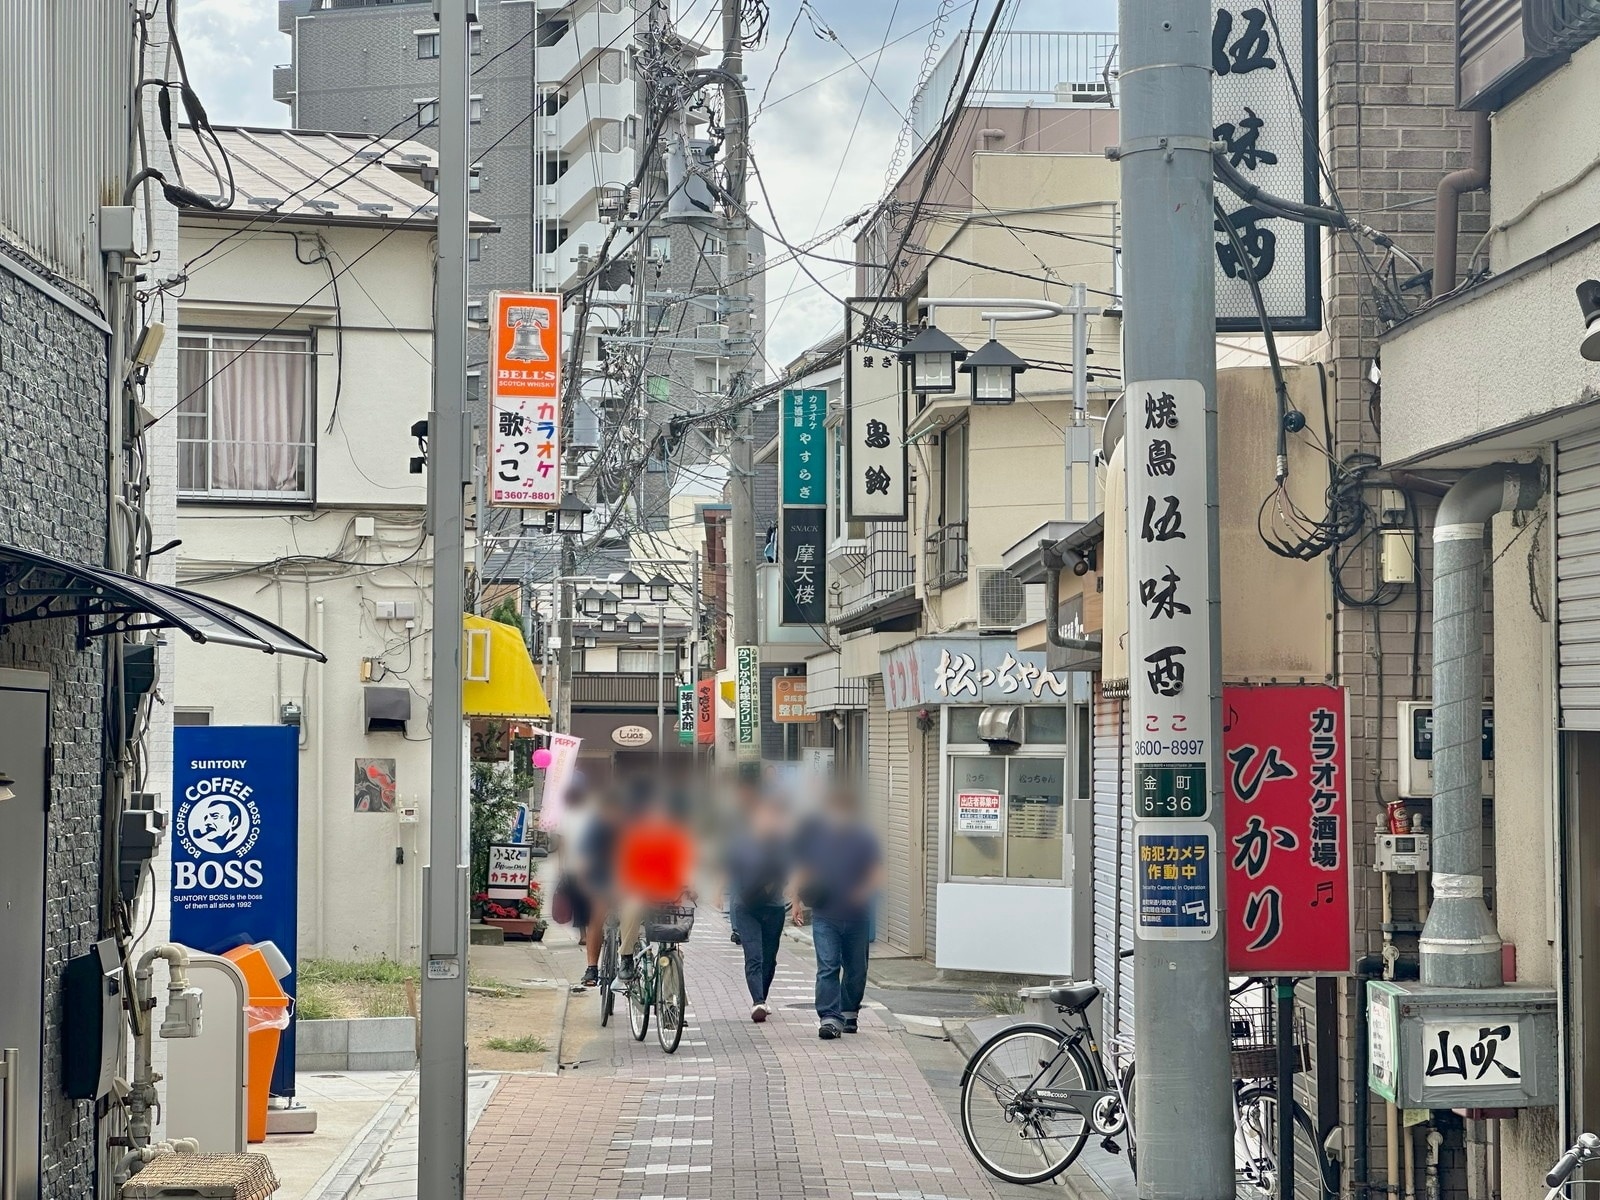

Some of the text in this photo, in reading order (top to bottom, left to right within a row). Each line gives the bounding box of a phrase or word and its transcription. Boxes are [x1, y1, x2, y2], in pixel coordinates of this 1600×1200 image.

[498, 369, 556, 380] BELL'S
[809, 395, 818, 430] カラオケ
[499, 412, 530, 482] 歌っこ
[537, 402, 555, 479] カラオケ
[799, 432, 812, 499] やすらぎ
[504, 491, 555, 500] 3607-8801
[790, 525, 819, 533] SNACK
[794, 543, 816, 605] 摩天楼
[934, 648, 1067, 698] 松っちゃん
[1146, 714, 1187, 732] ここ
[554, 737, 577, 748] PEPPY
[619, 729, 644, 739] Luas
[1135, 739, 1204, 756] 3600-8997
[191, 759, 247, 770] SUNTORY
[185, 777, 253, 802] COFFEE
[1144, 775, 1192, 790] 金町
[1310, 708, 1339, 871] カラオケ酒場
[1144, 796, 1192, 811] 5-36
[177, 801, 201, 859] BOSS COFFEE
[235, 801, 261, 858] BOSS COFFEE
[1141, 845, 1206, 862] 防犯カメラ
[1227, 743, 1298, 952] ひかり
[174, 859, 264, 890] BOSS
[491, 872, 527, 883] カラオケ
[1148, 863, 1197, 880] 作動中
[173, 894, 208, 902] SUNTORY
[1425, 1025, 1521, 1080] 山吹
